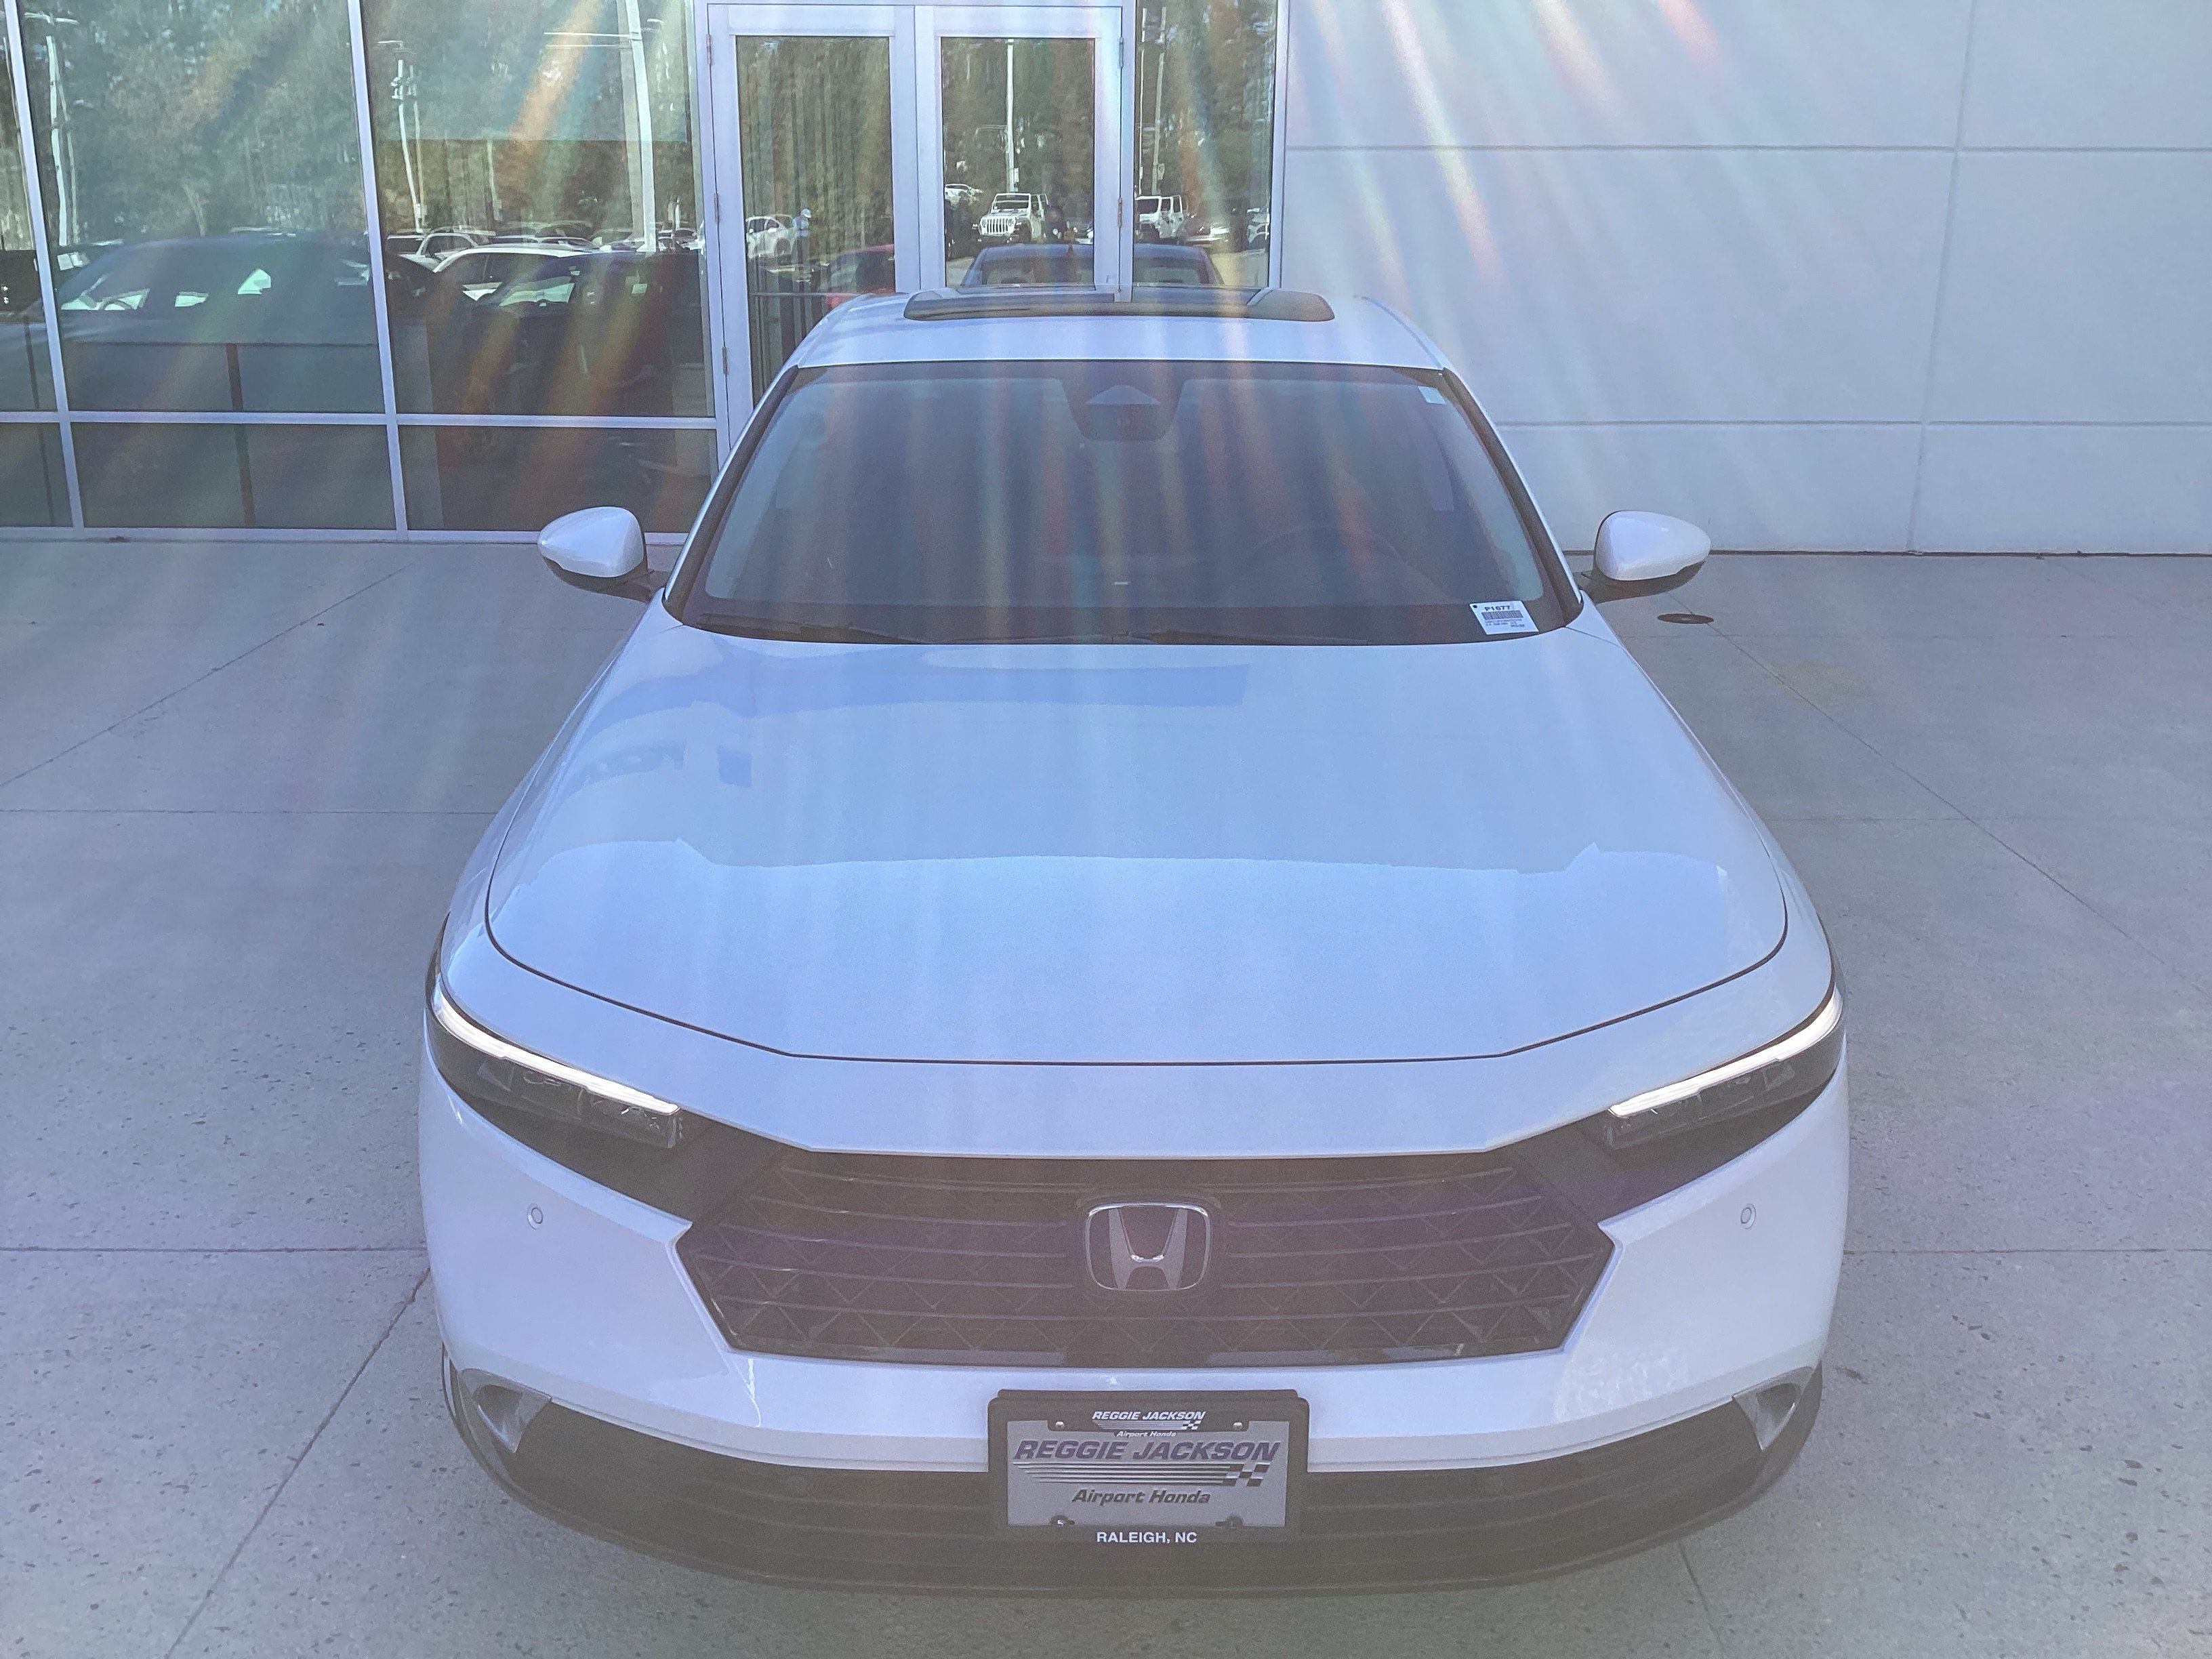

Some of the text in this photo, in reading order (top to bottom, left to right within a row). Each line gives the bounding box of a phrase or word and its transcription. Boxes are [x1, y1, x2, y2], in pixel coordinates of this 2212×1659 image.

[1092, 1411, 1206, 1420] REGGIE JACKSON
[1013, 1440, 1281, 1461] REGGIE JACKSON
[1071, 1489, 1211, 1507] Airport Honda
[1096, 1532, 1198, 1544] RALEIGH, NC
